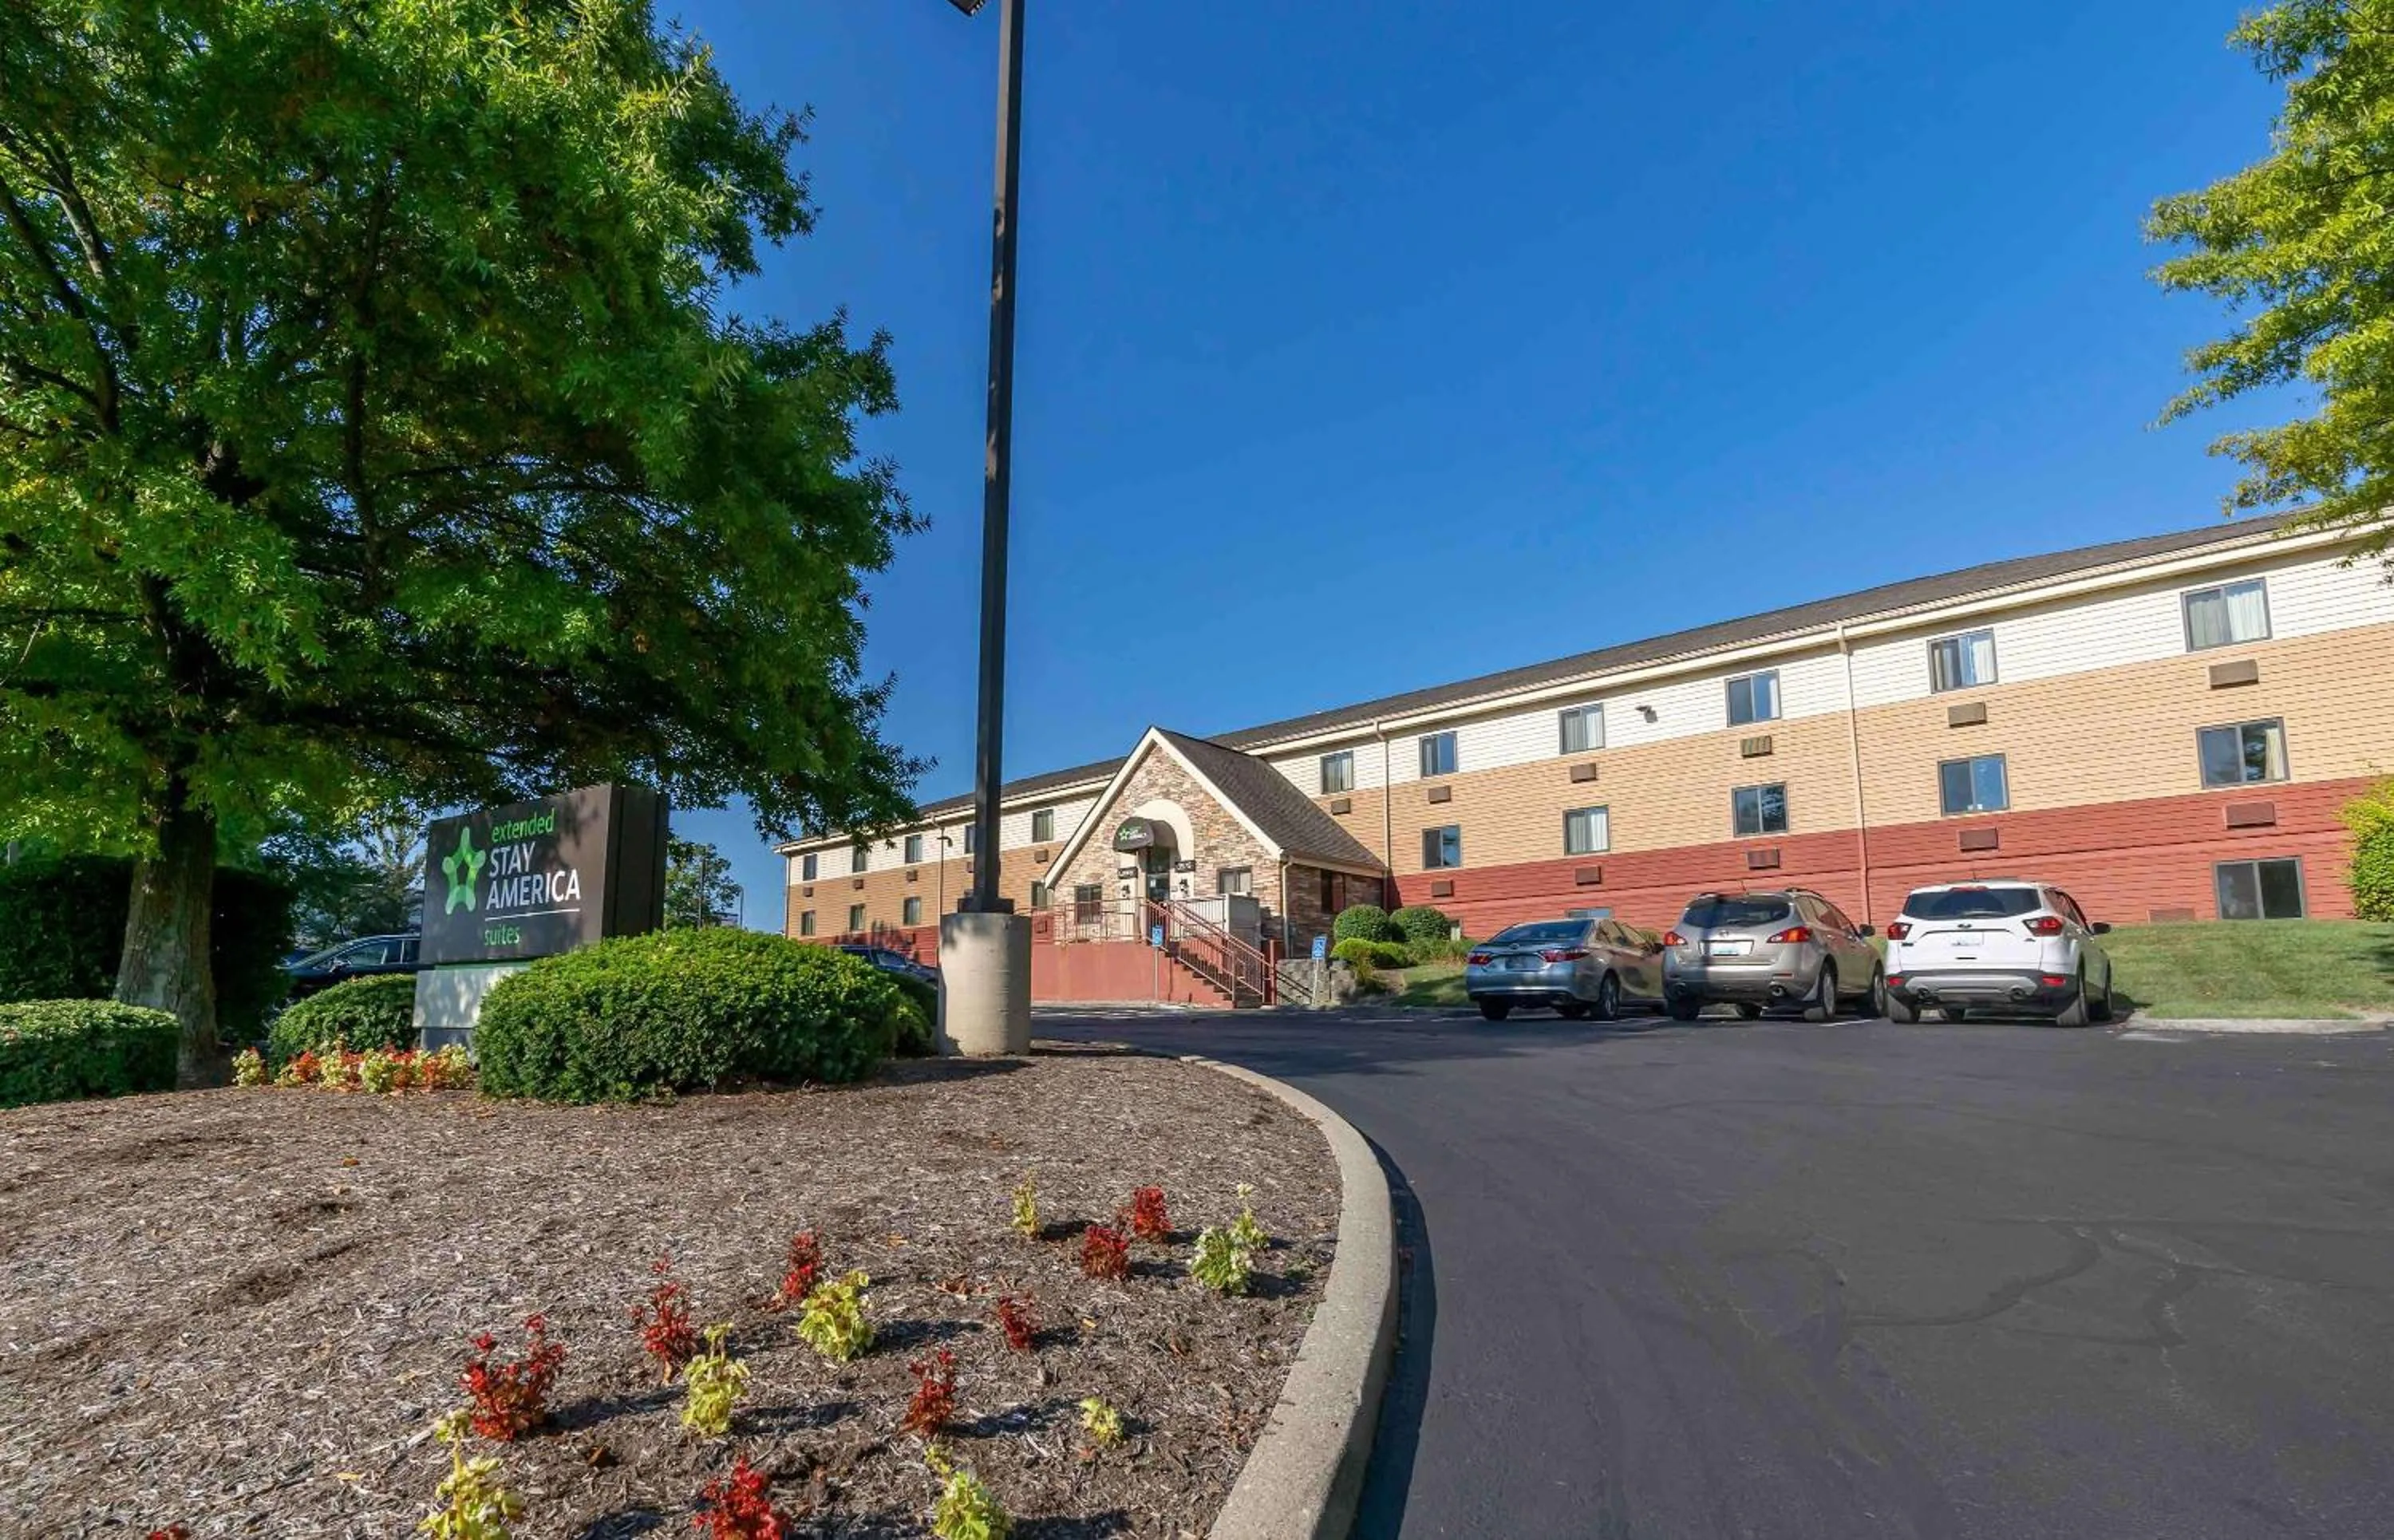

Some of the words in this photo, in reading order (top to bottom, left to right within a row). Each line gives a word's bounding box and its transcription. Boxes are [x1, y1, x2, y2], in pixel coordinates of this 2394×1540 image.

[492, 808, 555, 843] extended
[489, 841, 536, 878] STAY
[486, 868, 582, 910] AMERICA
[484, 923, 520, 946] suites
